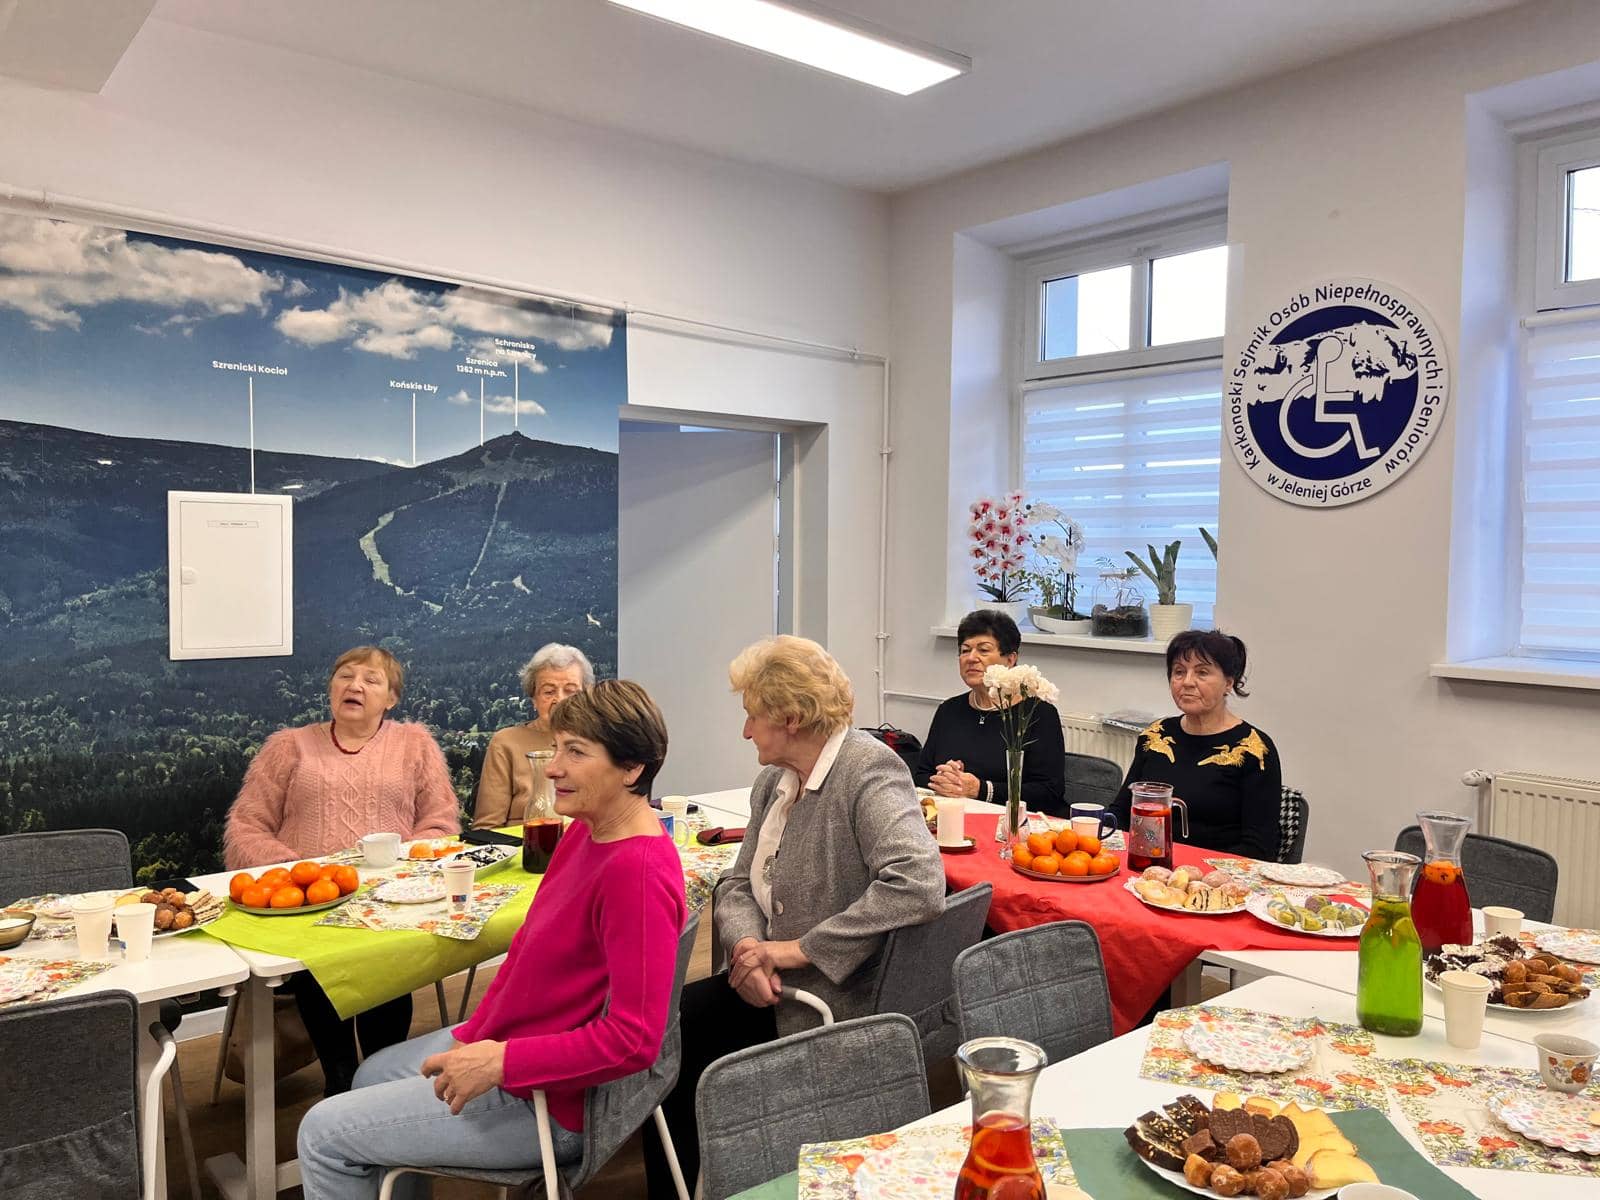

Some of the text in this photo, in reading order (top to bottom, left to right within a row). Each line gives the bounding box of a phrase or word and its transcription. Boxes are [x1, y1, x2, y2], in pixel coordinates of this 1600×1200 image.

[1269, 293, 1310, 327] Osób
[494, 338, 536, 350] Schronisko
[1315, 283, 1444, 380] Niepełnosprawnych
[212, 360, 257, 373] Szrenicki
[465, 357, 498, 368] Szrenica
[1234, 325, 1271, 380] Sejmik
[390, 380, 423, 391] Końskie
[1228, 381, 1261, 470] Karkonoski
[1385, 395, 1440, 473] Seniorów
[1267, 473, 1372, 503] w Jeleniej Górze
